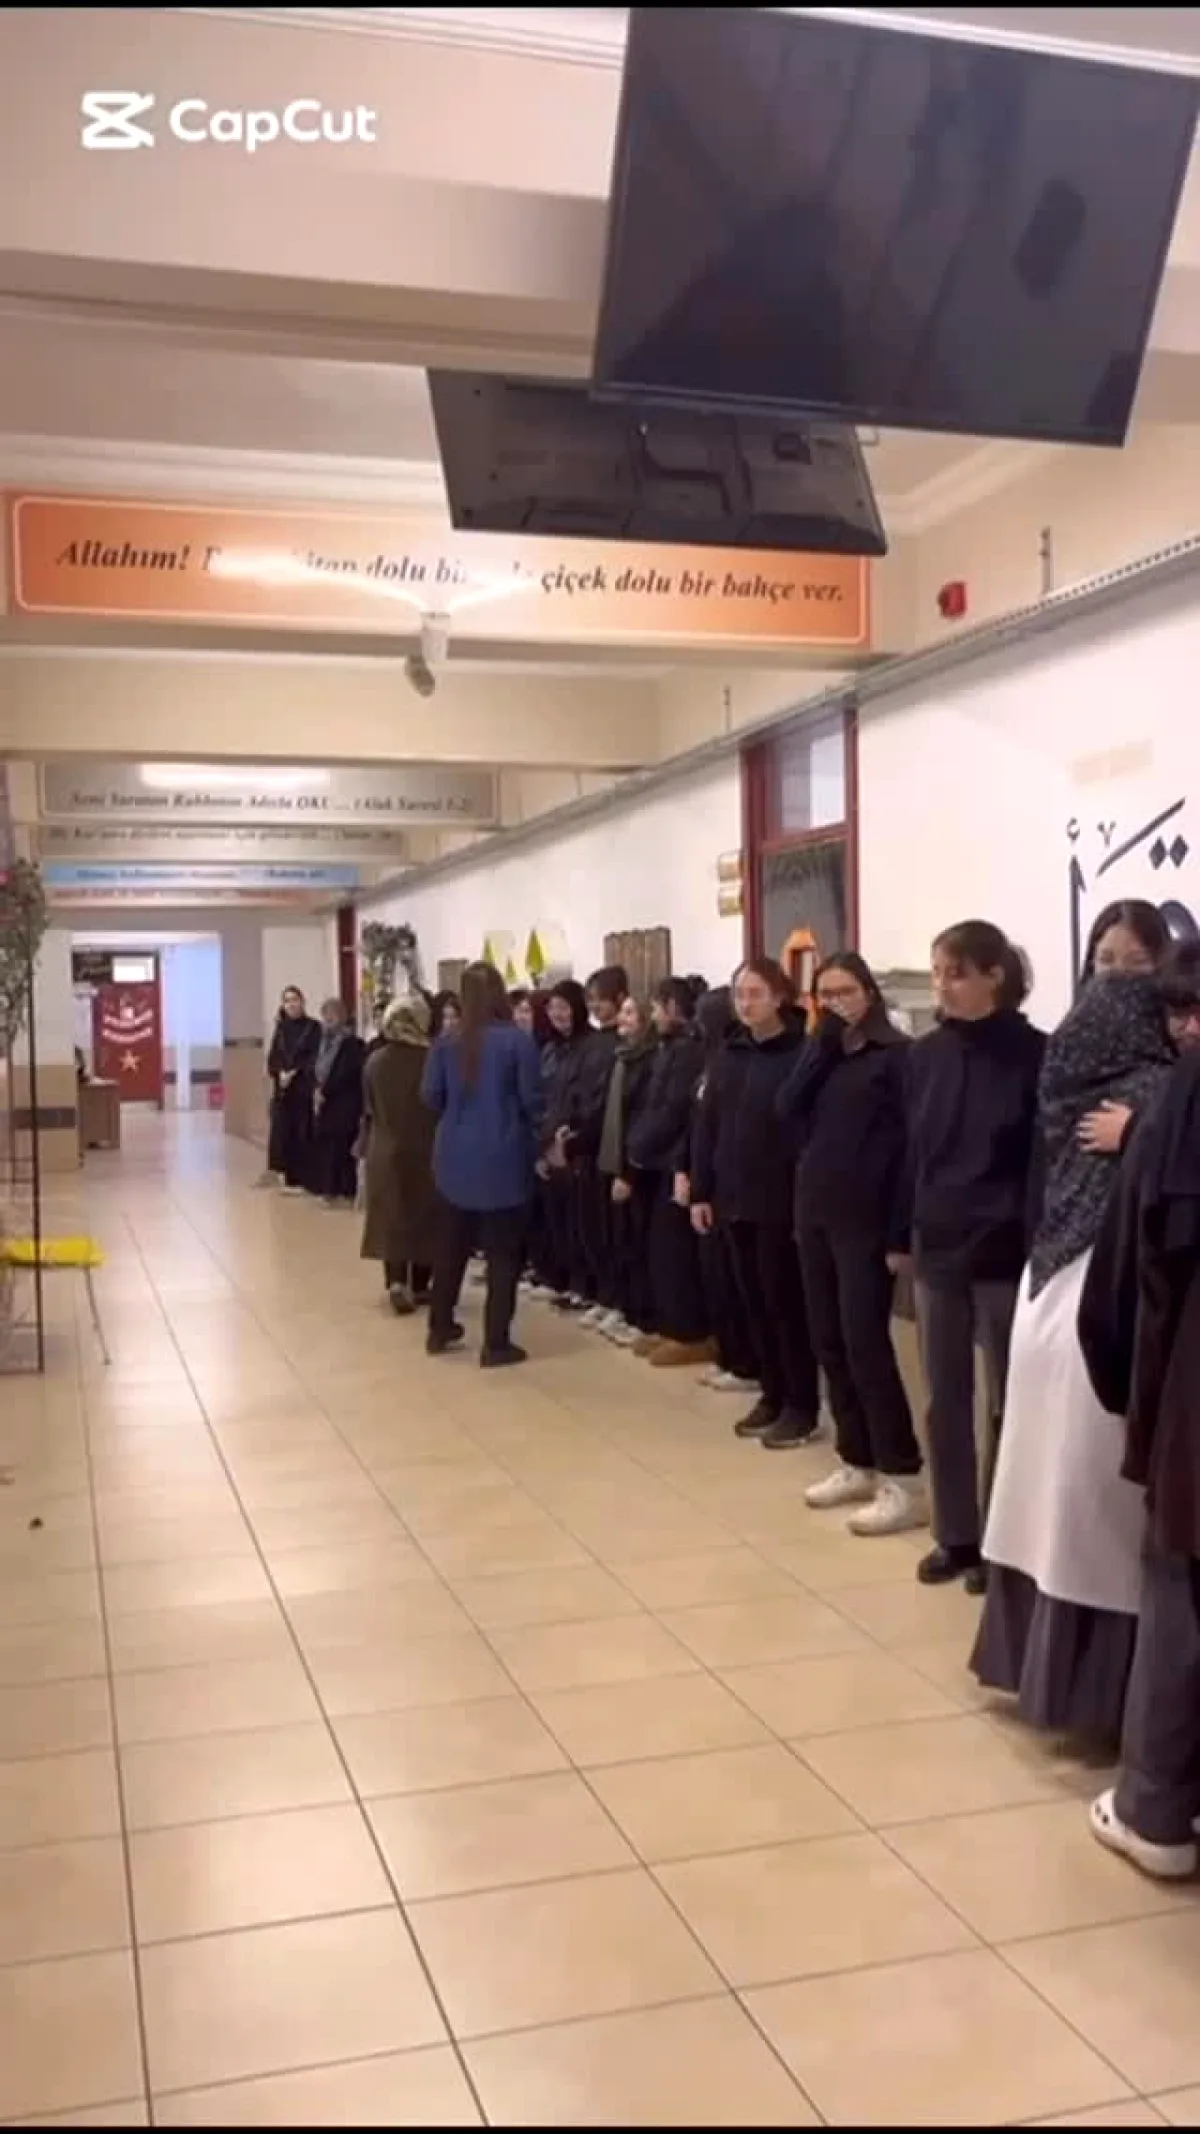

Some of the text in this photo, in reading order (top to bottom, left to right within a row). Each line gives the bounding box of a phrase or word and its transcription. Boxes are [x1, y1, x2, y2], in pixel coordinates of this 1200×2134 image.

[366, 555, 426, 584] dolu
[541, 563, 607, 596] çiçek
[614, 567, 671, 594] dolu
[679, 568, 717, 597] bir
[721, 572, 797, 605] bahçe
